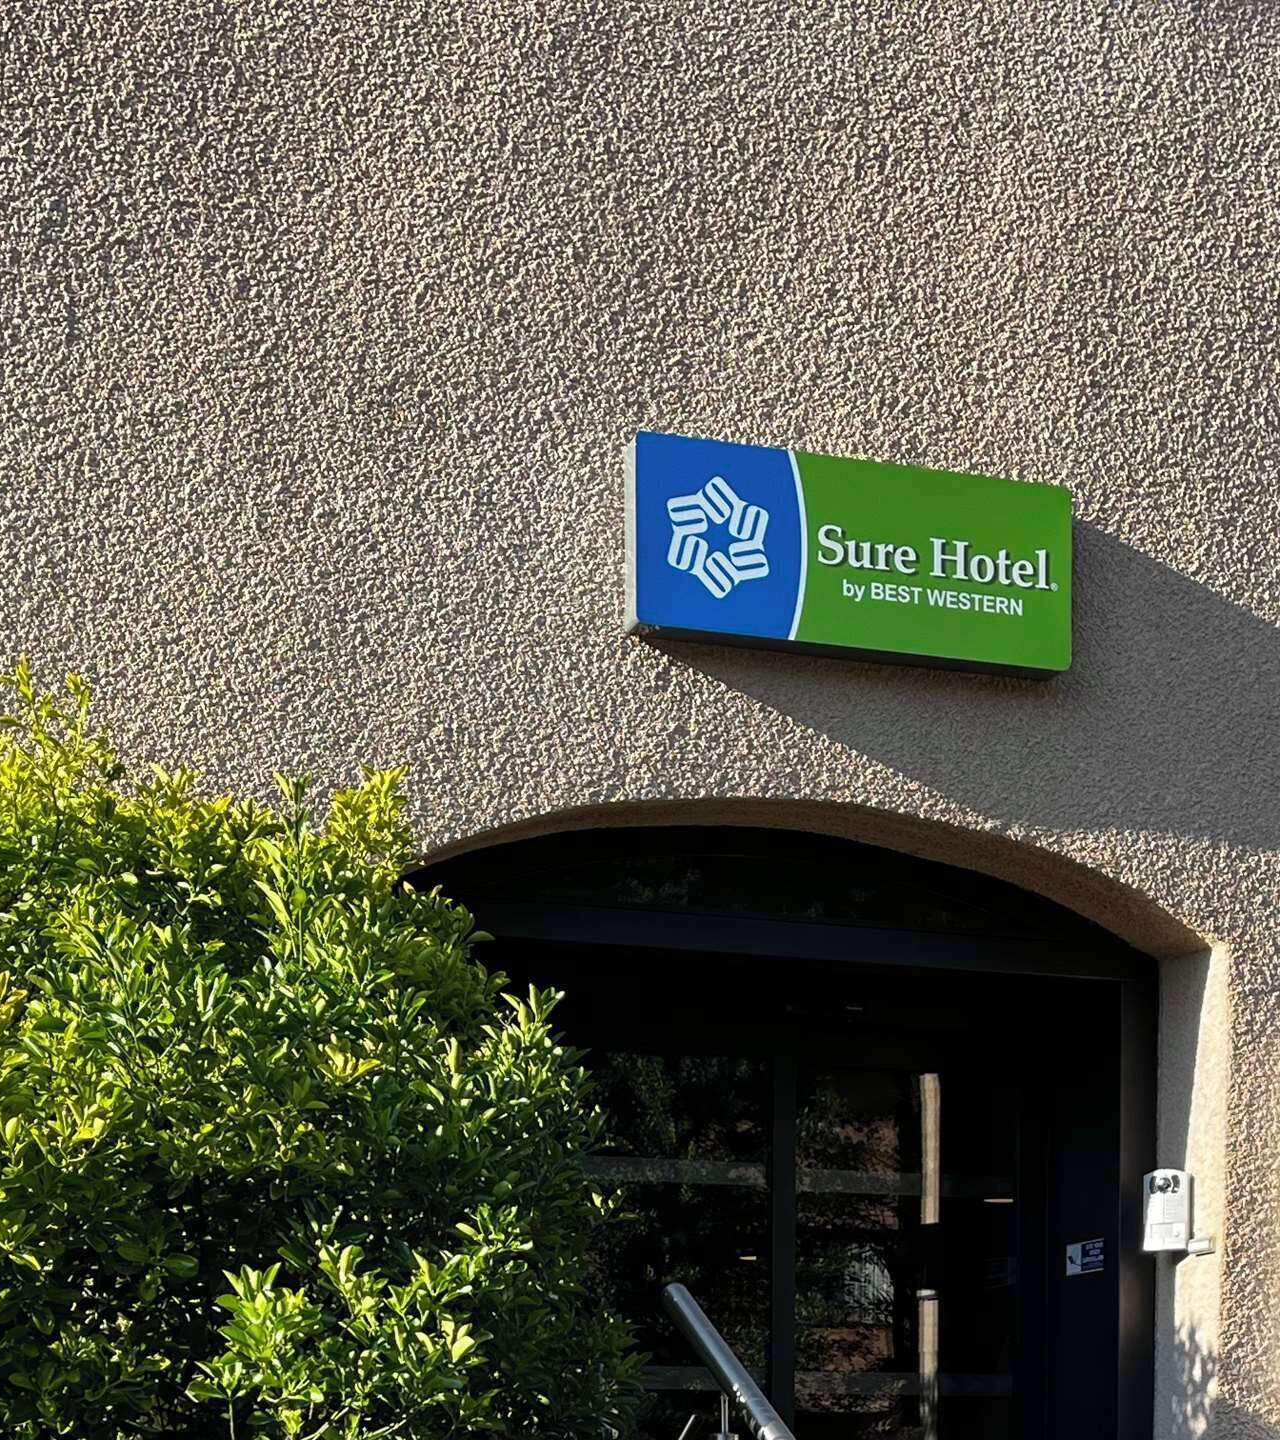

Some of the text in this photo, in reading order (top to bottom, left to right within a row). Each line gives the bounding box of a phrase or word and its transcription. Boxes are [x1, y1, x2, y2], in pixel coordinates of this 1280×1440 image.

[817, 524, 916, 574] Sure
[842, 579, 1024, 616] by BEST WESTERN
